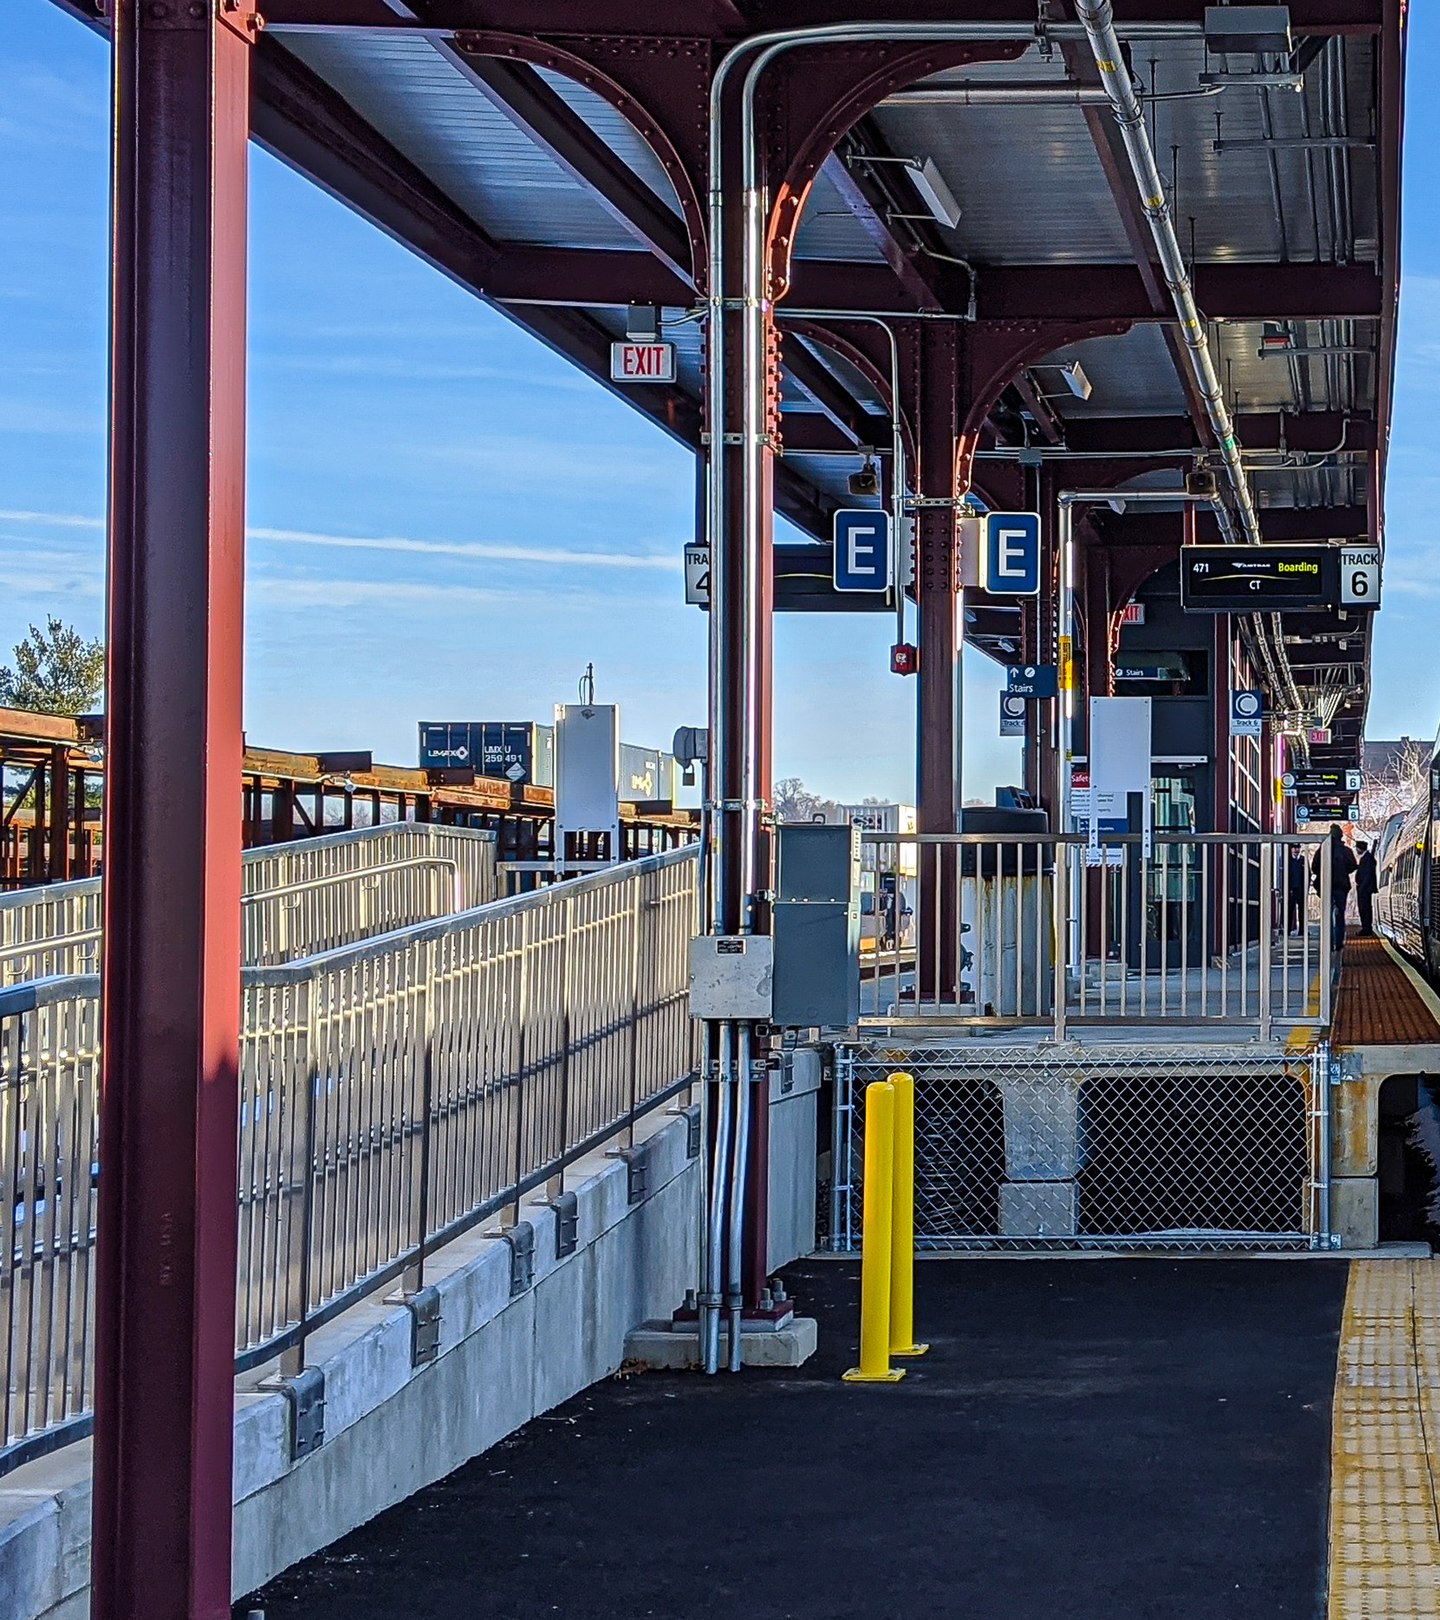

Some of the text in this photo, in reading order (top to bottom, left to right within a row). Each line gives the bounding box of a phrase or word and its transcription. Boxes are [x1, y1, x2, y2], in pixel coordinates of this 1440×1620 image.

[623, 347, 664, 375] EXIT
[848, 527, 875, 574] E
[998, 530, 1026, 577] E
[687, 553, 709, 565] TRA
[1342, 553, 1378, 565] TRACK
[1193, 563, 1209, 573] 471
[1278, 562, 1318, 574] Boarding
[1249, 581, 1261, 590] CT
[1351, 571, 1368, 597] 6
[1009, 683, 1034, 693] Stairs
[1071, 774, 1090, 783] Safet
[1350, 777, 1357, 788] 6
